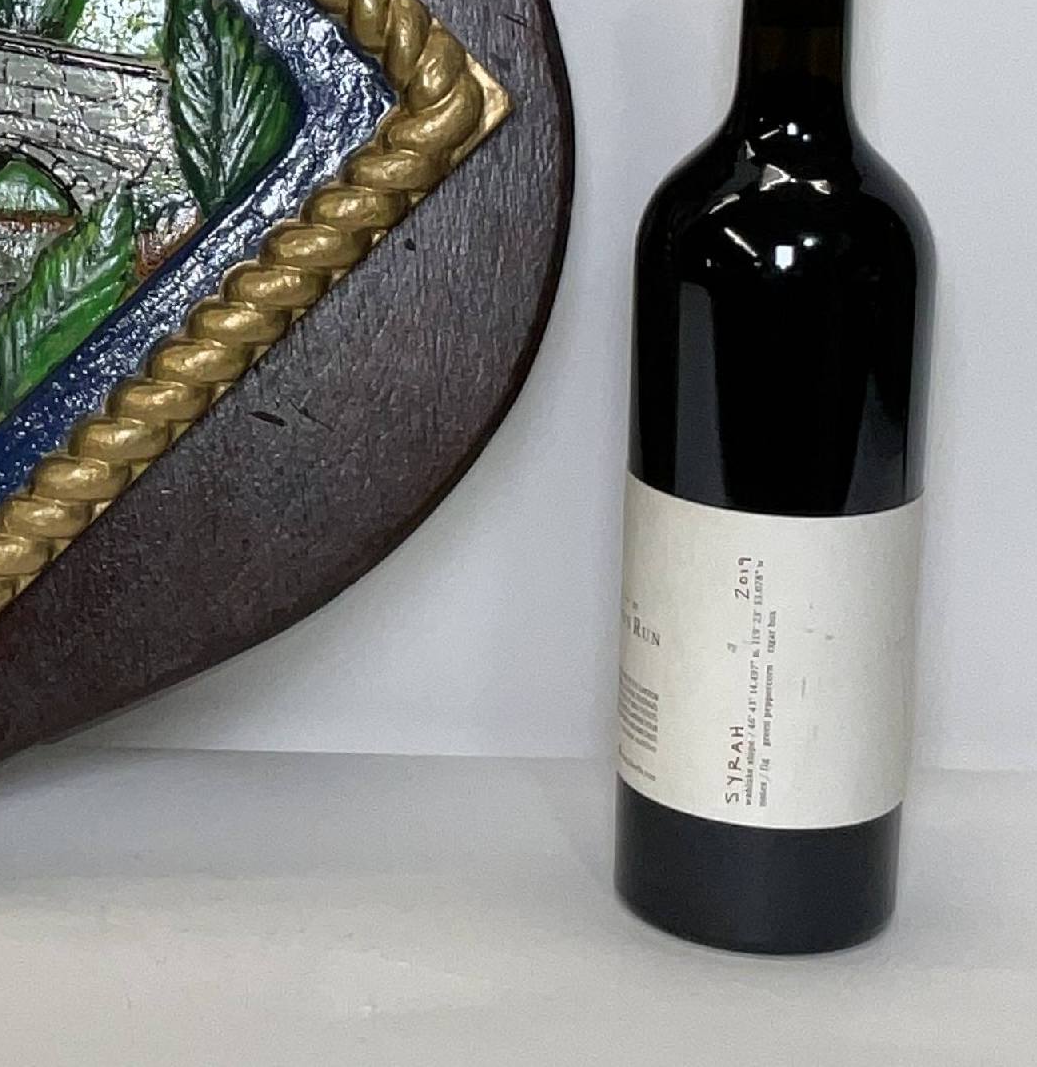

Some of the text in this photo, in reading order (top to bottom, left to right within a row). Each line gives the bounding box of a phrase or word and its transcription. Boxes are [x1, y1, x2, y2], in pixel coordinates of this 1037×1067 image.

[725, 557, 751, 804] SYRAH 2019
[763, 665, 774, 718] peppercorn
